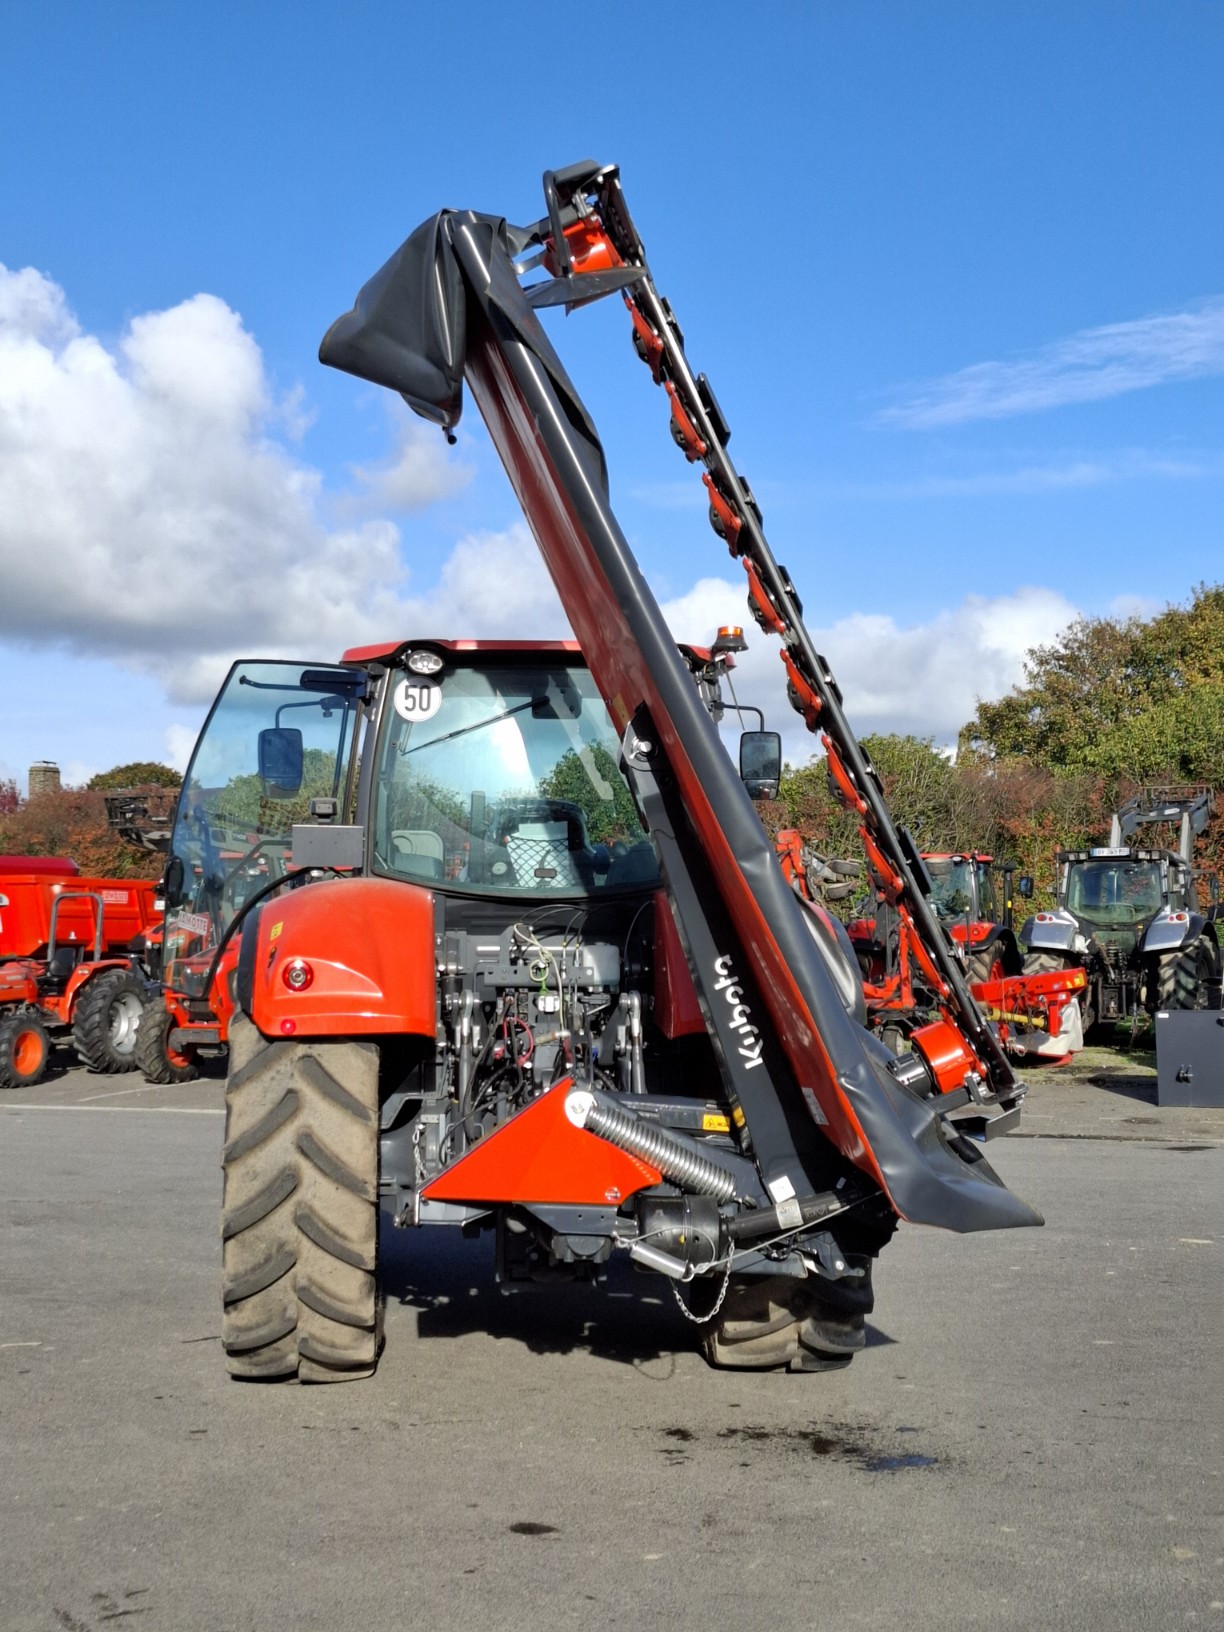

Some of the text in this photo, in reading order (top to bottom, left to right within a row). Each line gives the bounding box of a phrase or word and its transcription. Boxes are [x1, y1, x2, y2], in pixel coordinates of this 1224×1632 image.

[404, 684, 432, 712] 50
[179, 911, 207, 932] JAMOTTE
[714, 954, 764, 1070] Kubota
